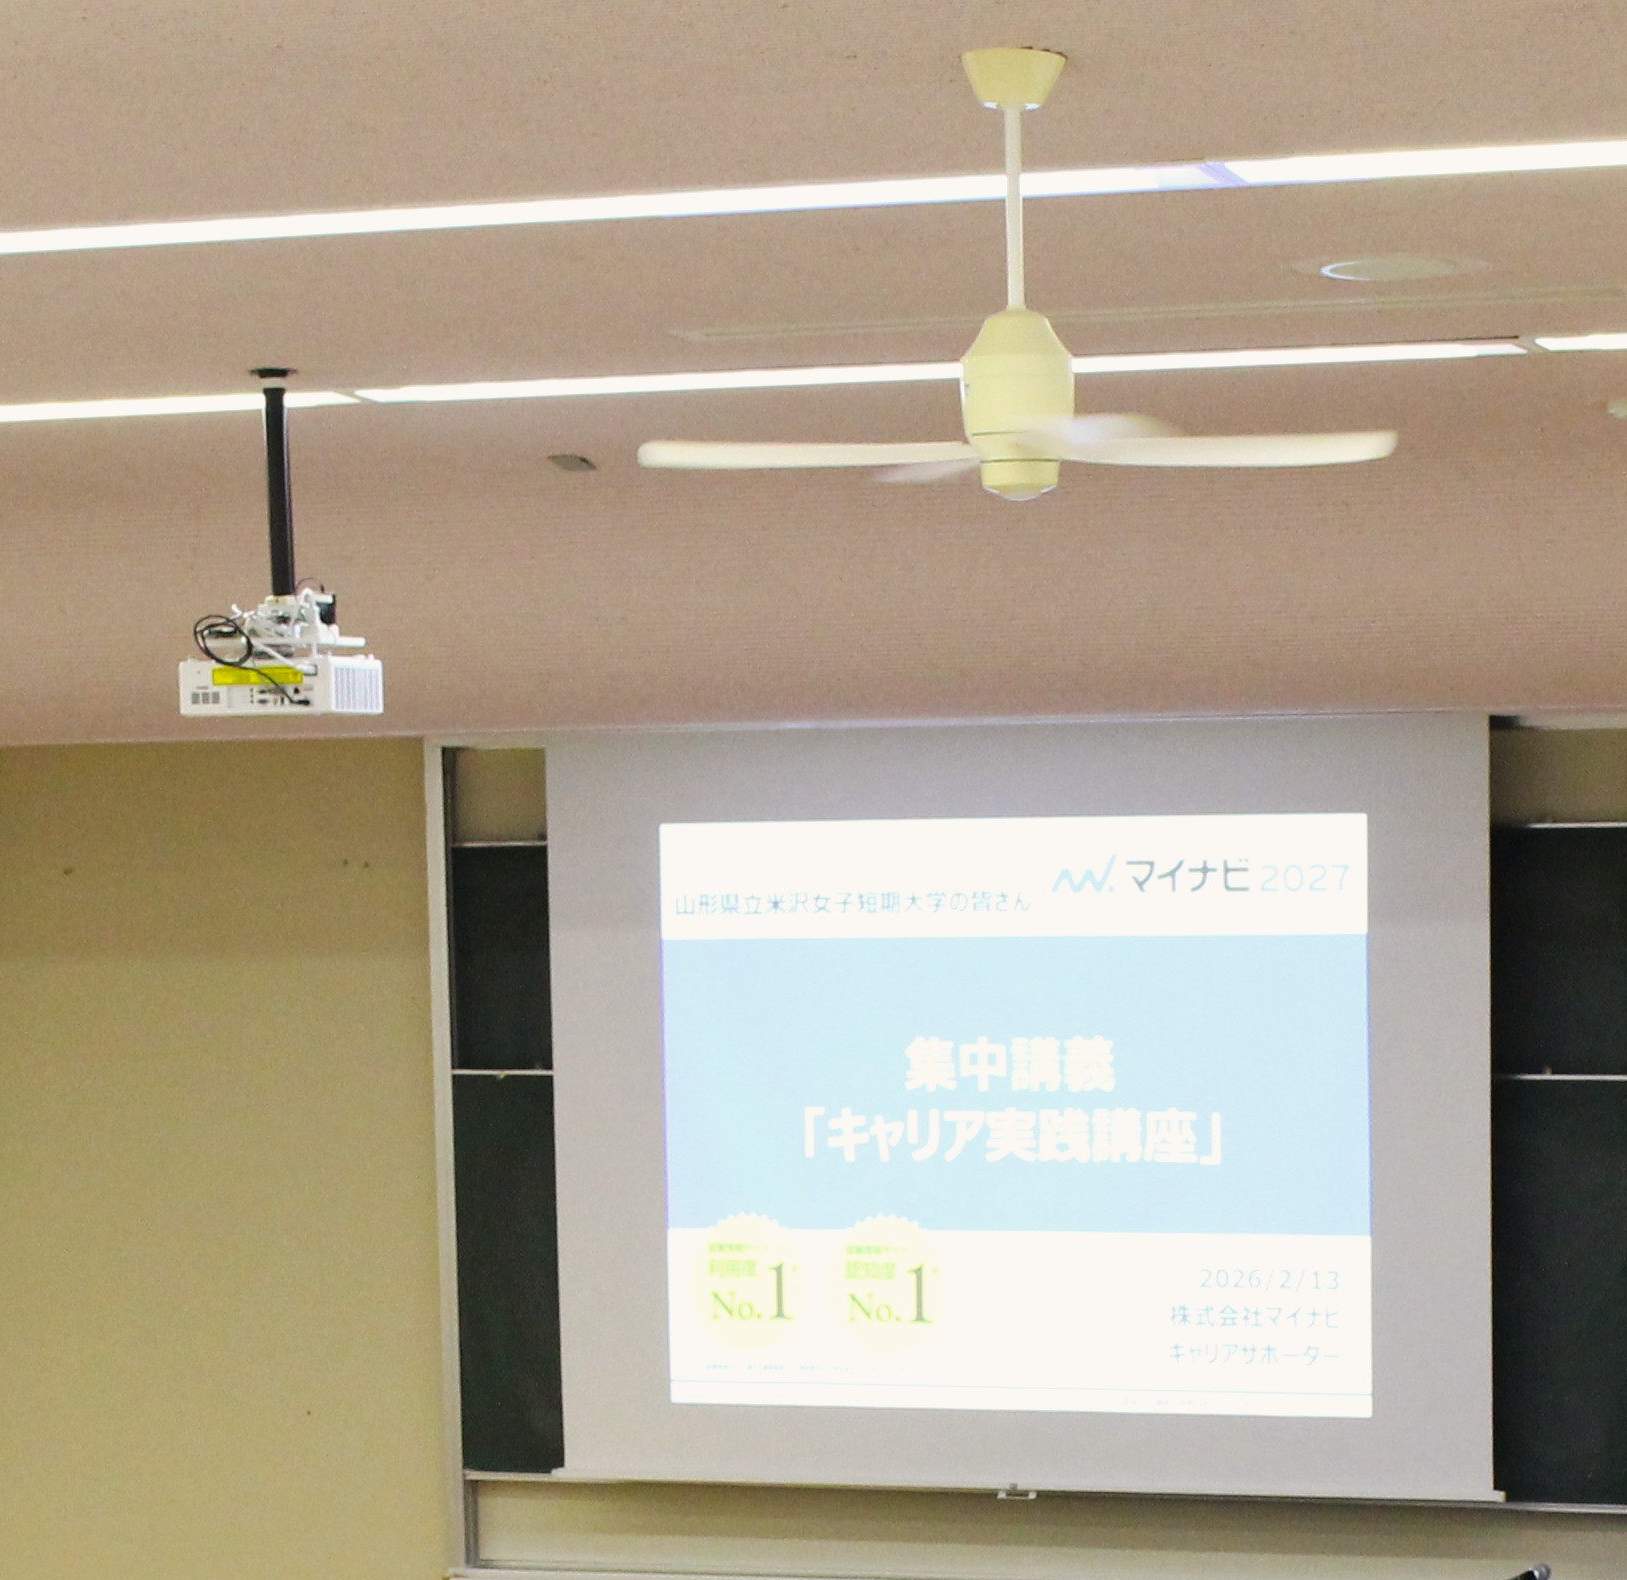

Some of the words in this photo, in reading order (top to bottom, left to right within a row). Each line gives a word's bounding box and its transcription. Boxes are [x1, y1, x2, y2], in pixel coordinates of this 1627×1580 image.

[675, 891, 1031, 916] 山形県立米沢女子短期大学の皆さん
[903, 1035, 1116, 1092] 集中講義
[803, 1105, 1222, 1166] 「キャリア実践講座」
[1200, 1268, 1340, 1293] 2026/2/13
